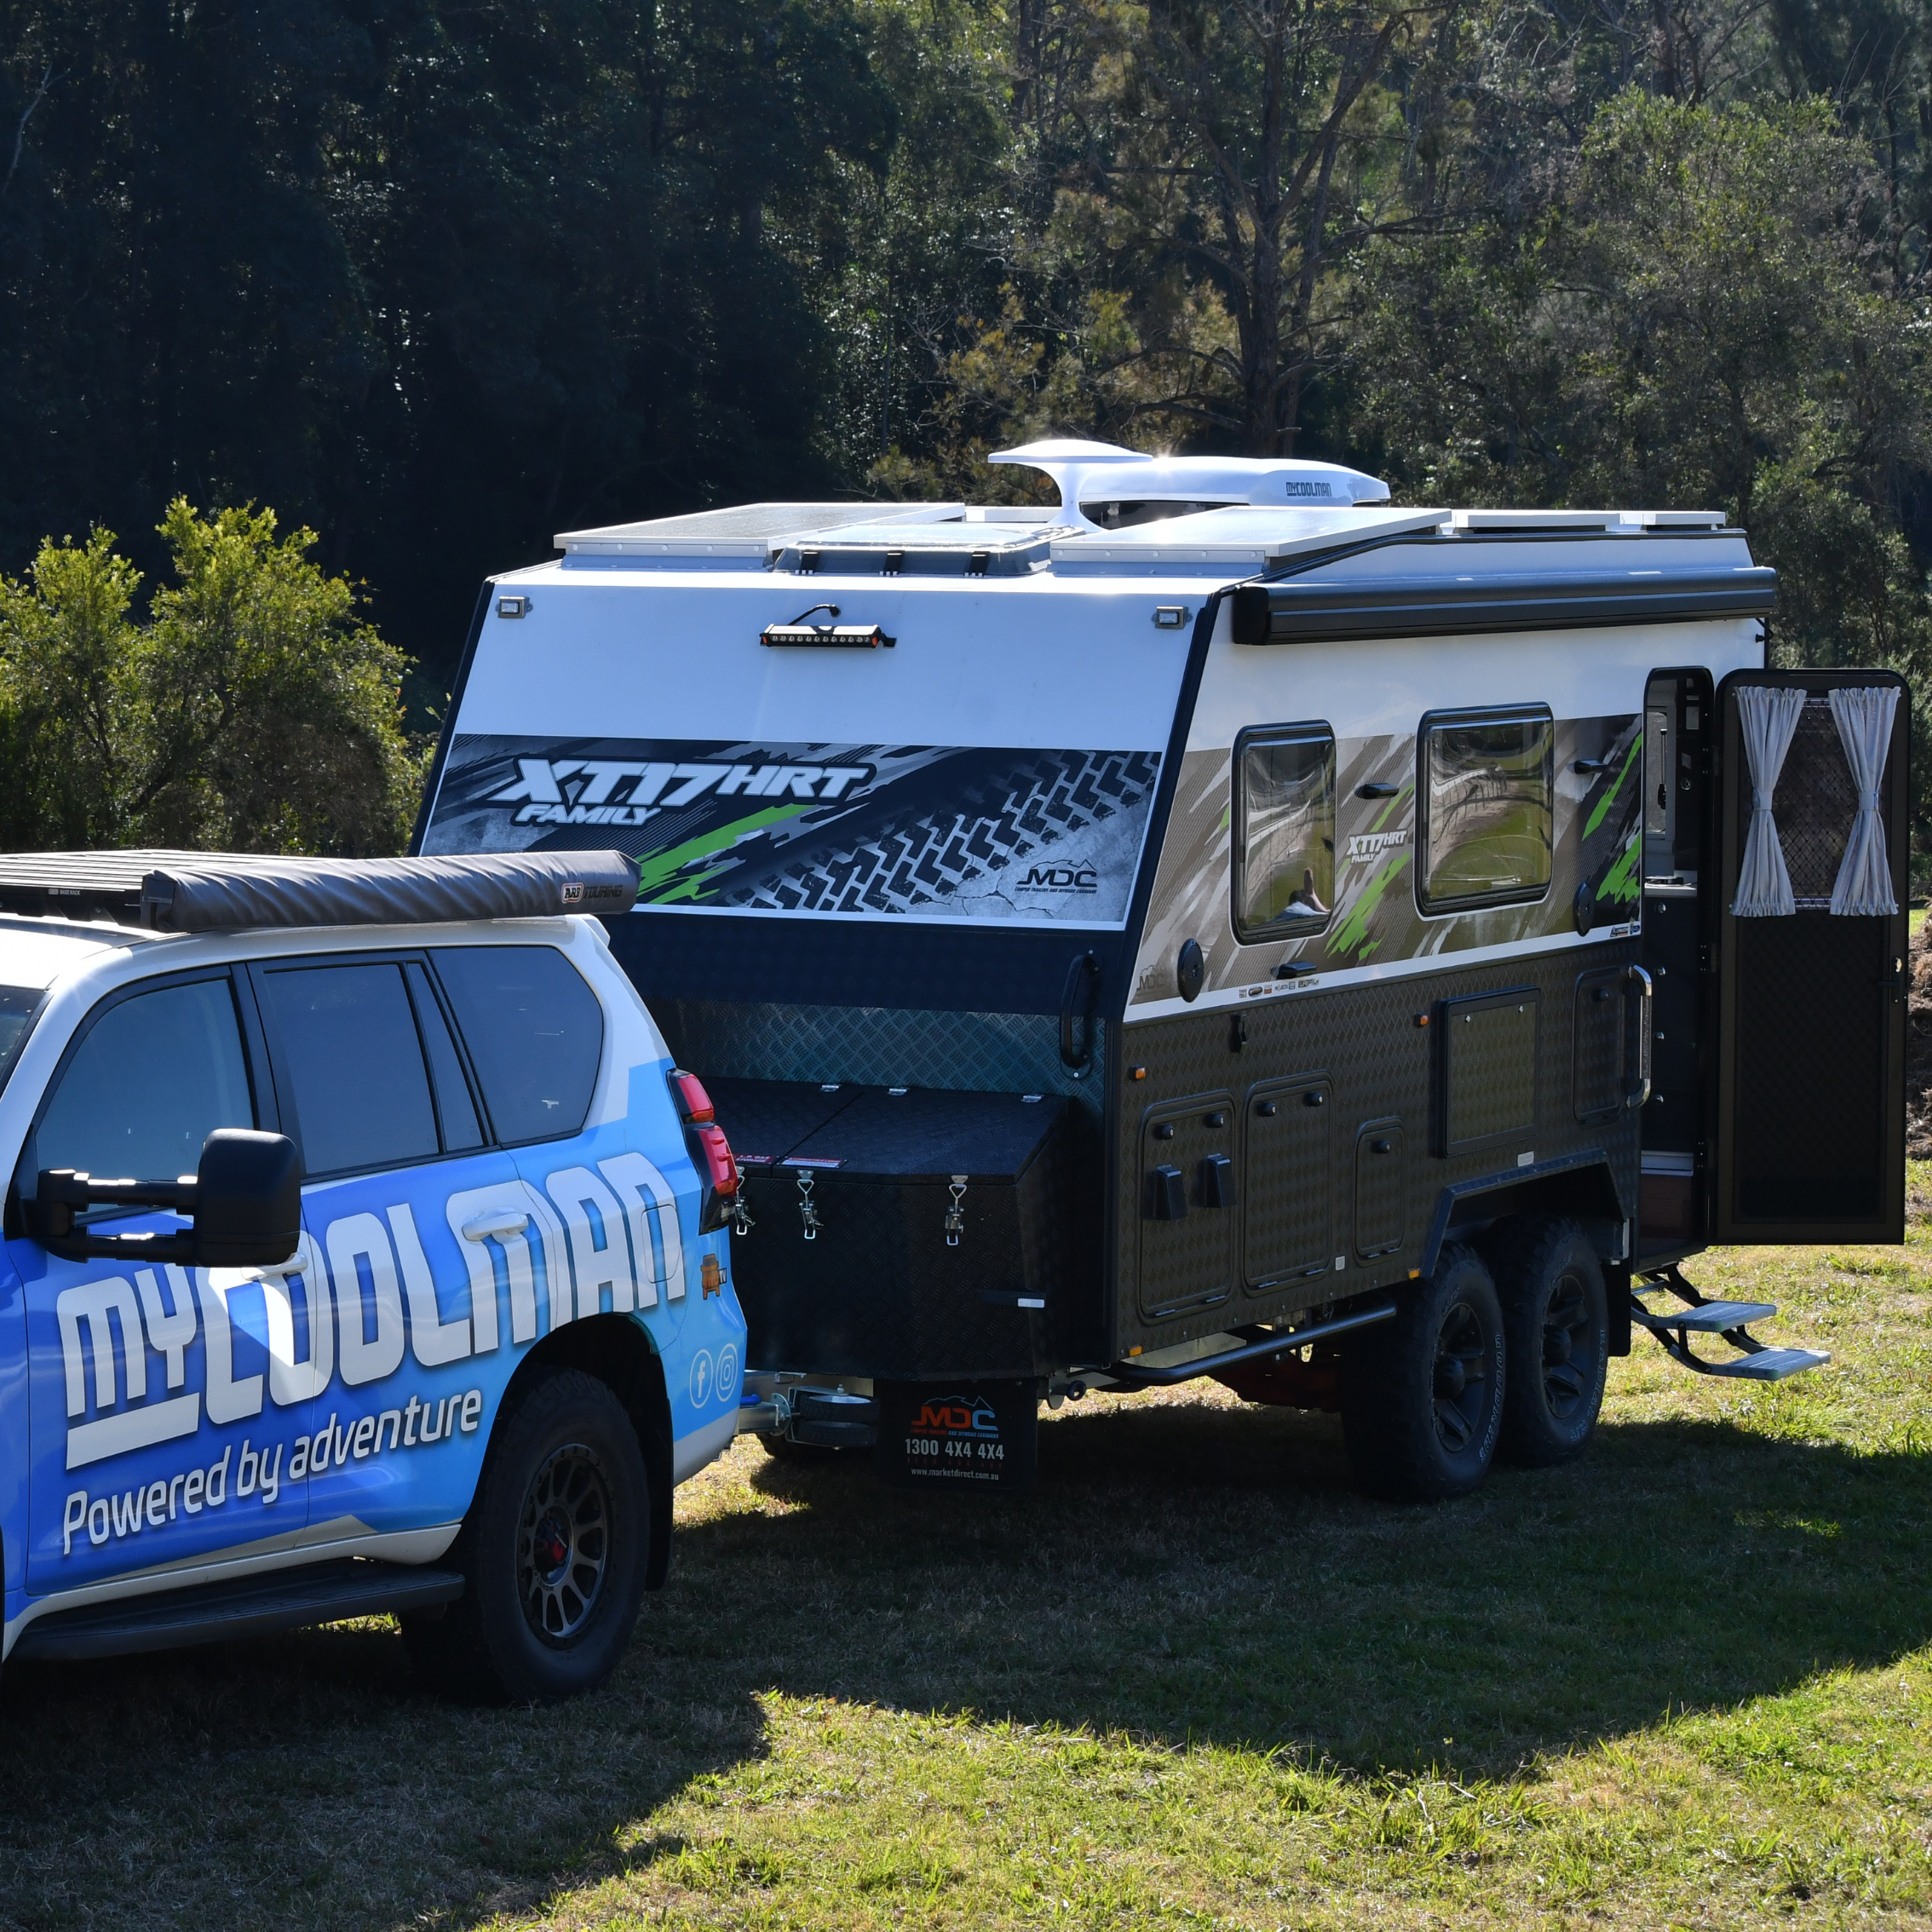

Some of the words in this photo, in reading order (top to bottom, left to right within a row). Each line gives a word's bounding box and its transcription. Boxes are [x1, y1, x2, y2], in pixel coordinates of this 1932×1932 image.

[515, 803, 662, 826] FAMILY
[1350, 853, 1376, 864] FAMILY
[1016, 868, 1098, 887] MDC
[911, 1406, 999, 1431] MDC
[905, 1438, 939, 1456] 1300
[945, 1440, 972, 1458] 4X4
[977, 1443, 1005, 1461] 4X4
[63, 1445, 232, 1555] Powered
[236, 1439, 283, 1504] by
[288, 1389, 482, 1480] adventure
[911, 1468, 999, 1481] www.marketdirect.com.au
